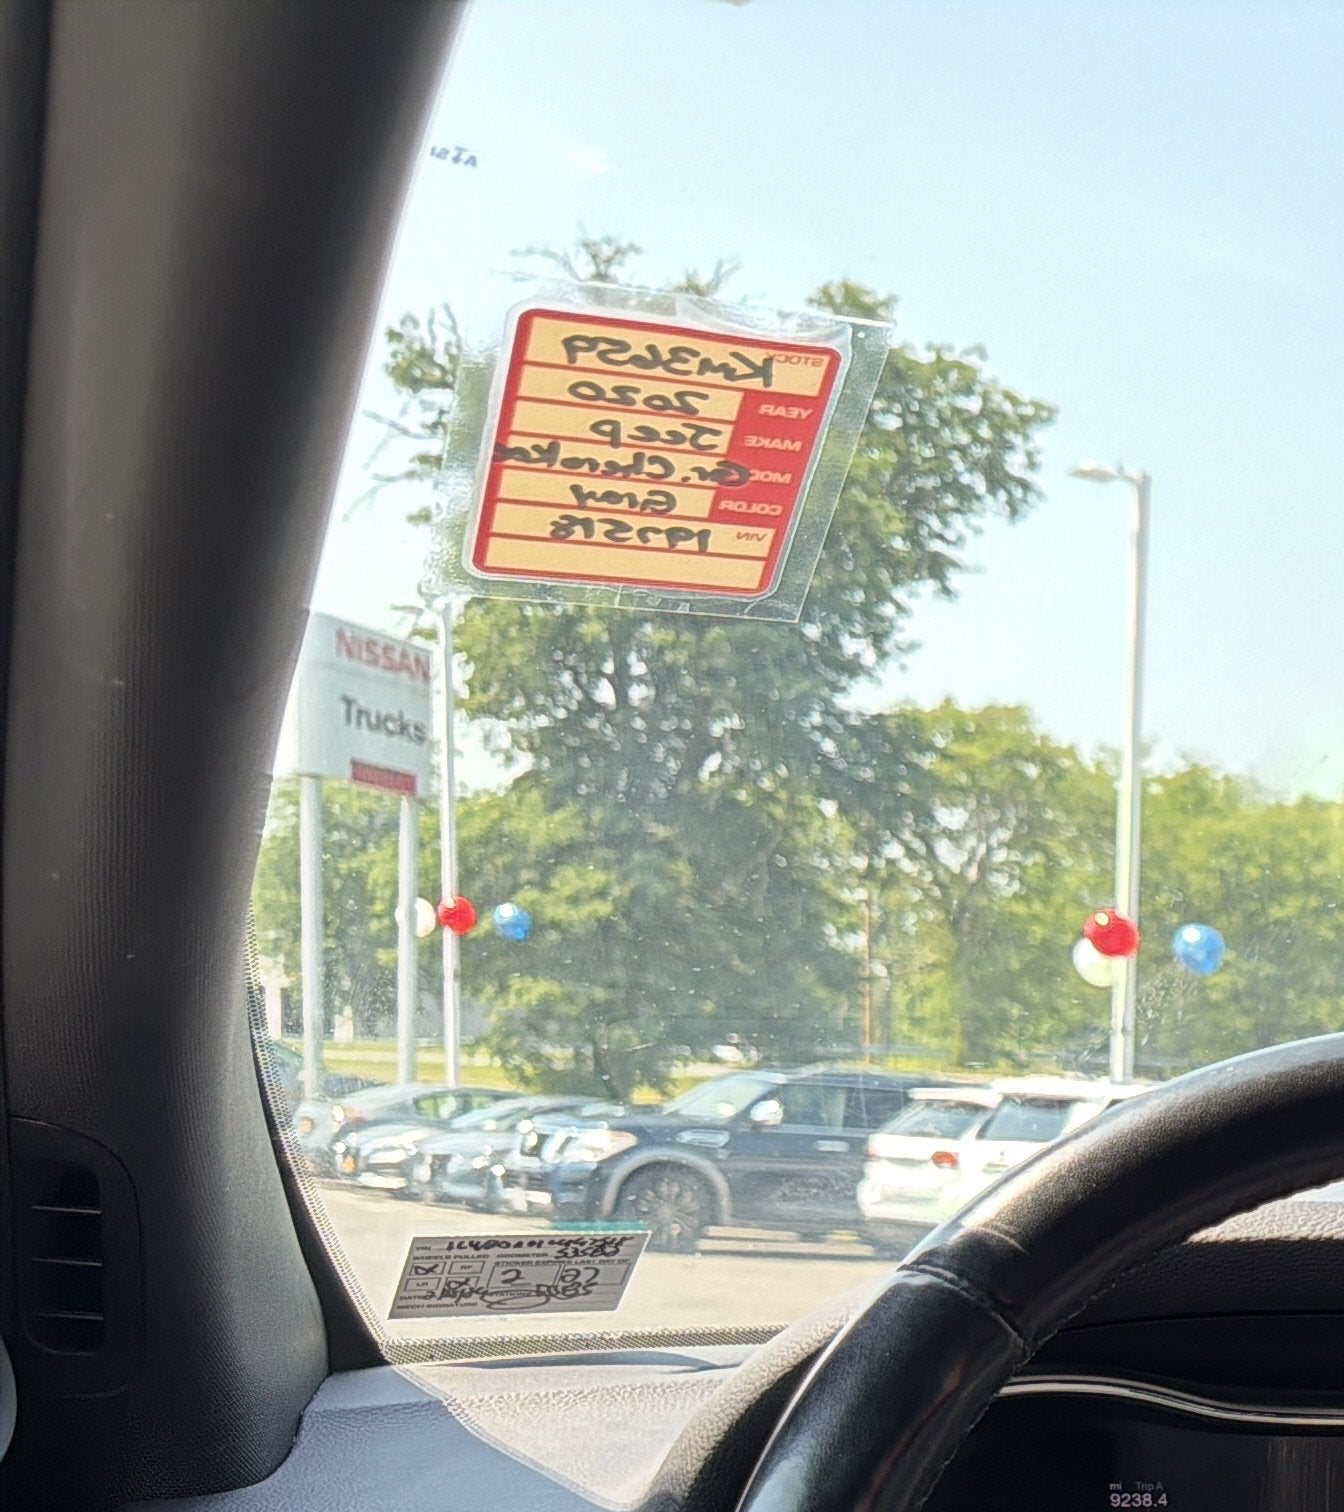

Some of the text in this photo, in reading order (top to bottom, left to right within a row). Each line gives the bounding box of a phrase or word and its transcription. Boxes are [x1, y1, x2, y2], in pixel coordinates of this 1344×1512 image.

[335, 626, 432, 683] NISSAN
[338, 695, 428, 745] Trucks
[1109, 1481, 1122, 1491] mi
[1110, 1492, 1168, 1508] 9238.4
